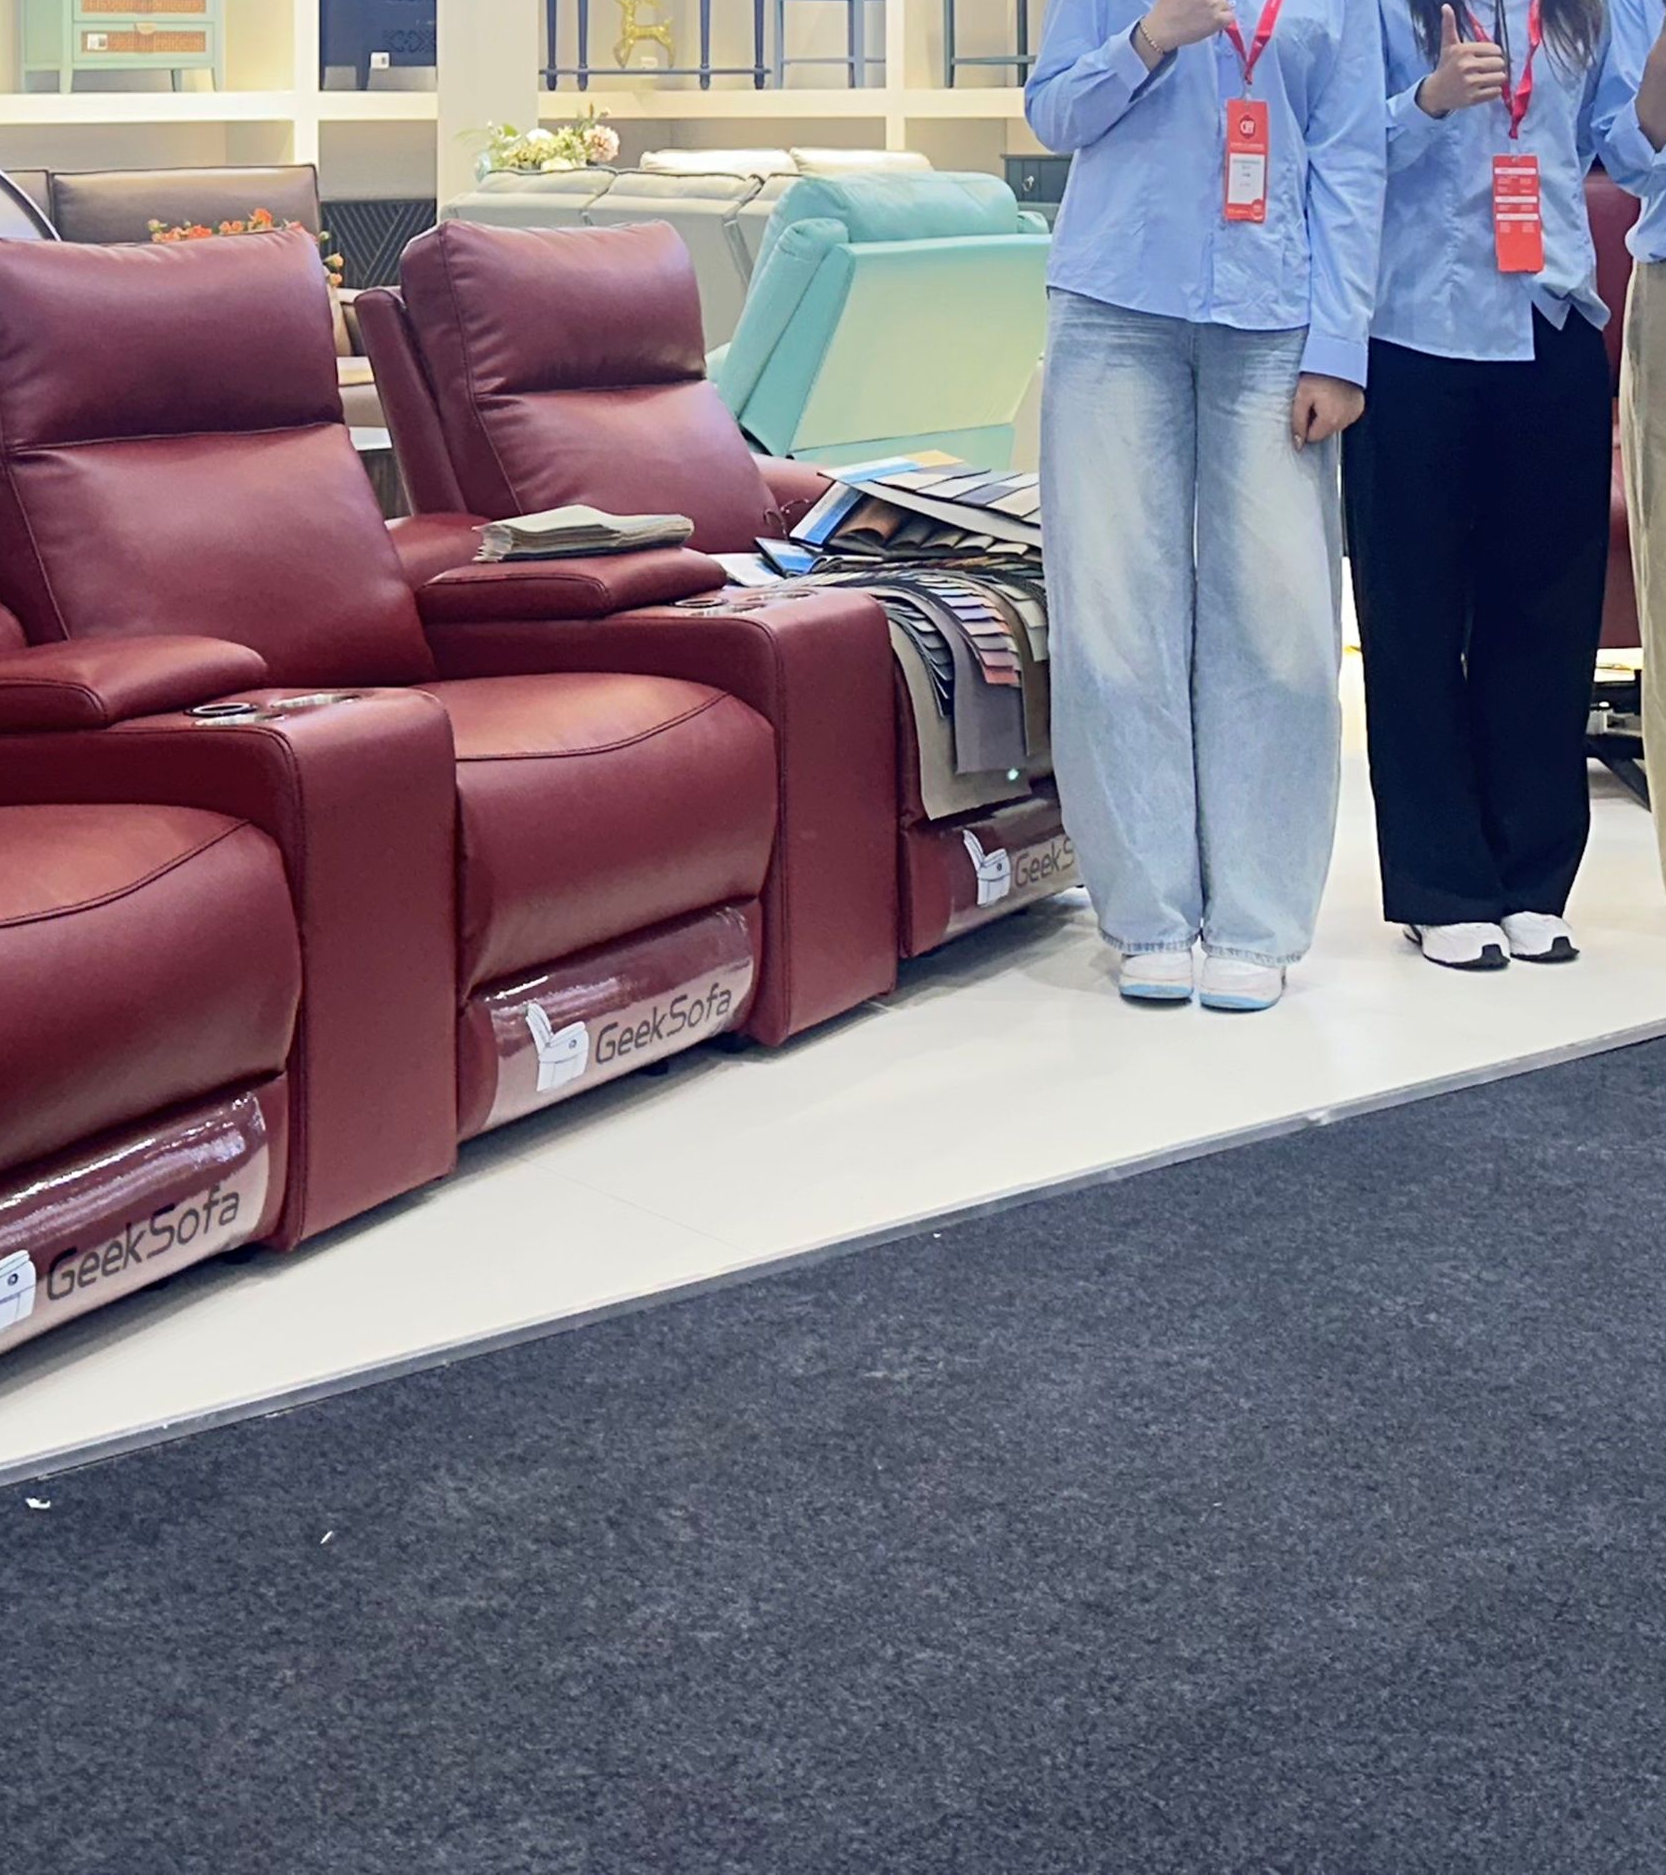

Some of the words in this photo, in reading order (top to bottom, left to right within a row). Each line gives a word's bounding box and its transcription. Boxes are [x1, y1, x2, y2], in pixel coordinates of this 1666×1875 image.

[1014, 837, 1075, 888] GeekS
[595, 983, 733, 1066] GeekSofa
[46, 1186, 241, 1302] GeekSofa
